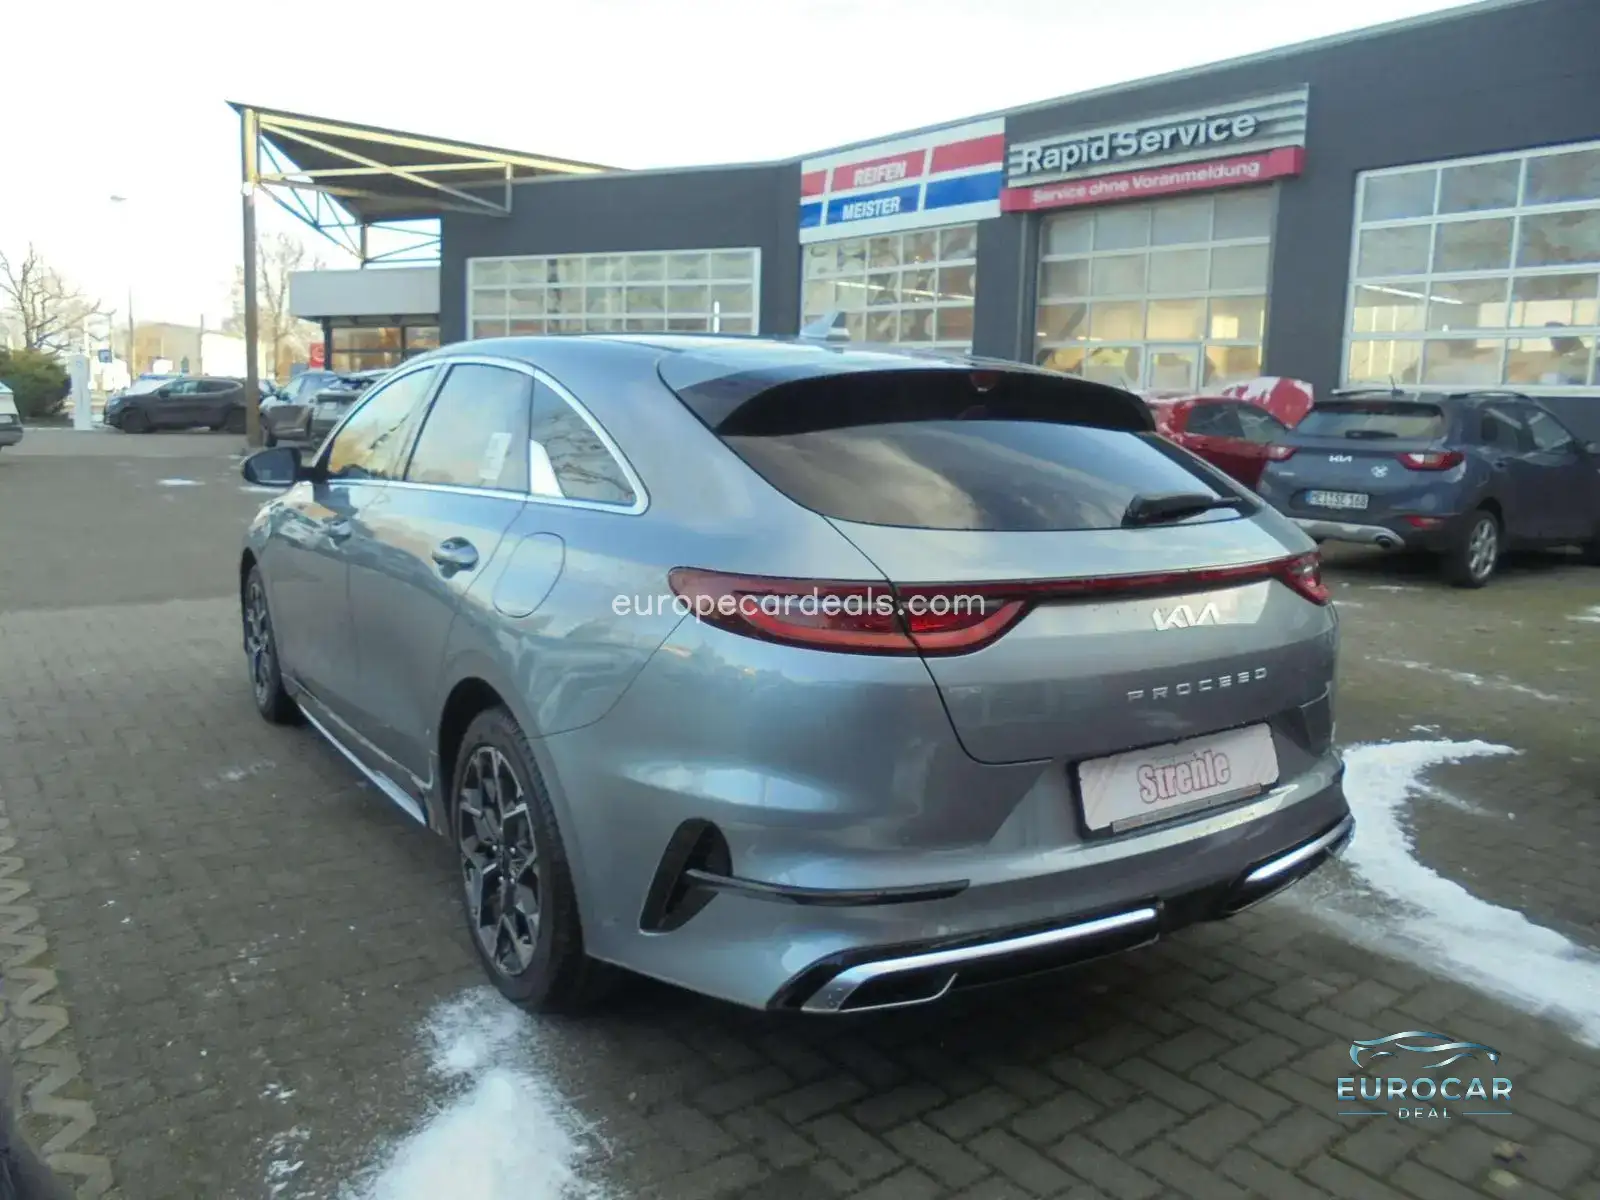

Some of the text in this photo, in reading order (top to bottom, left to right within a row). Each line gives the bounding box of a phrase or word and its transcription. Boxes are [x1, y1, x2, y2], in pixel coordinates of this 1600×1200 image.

[853, 160, 906, 188] REIFEN
[1033, 161, 1260, 204] Service ohne Voranmeldung
[842, 196, 901, 220] MEISTER
[1329, 455, 1352, 463] KIA
[1152, 602, 1220, 631] KIA
[1126, 667, 1267, 701] PROCEED
